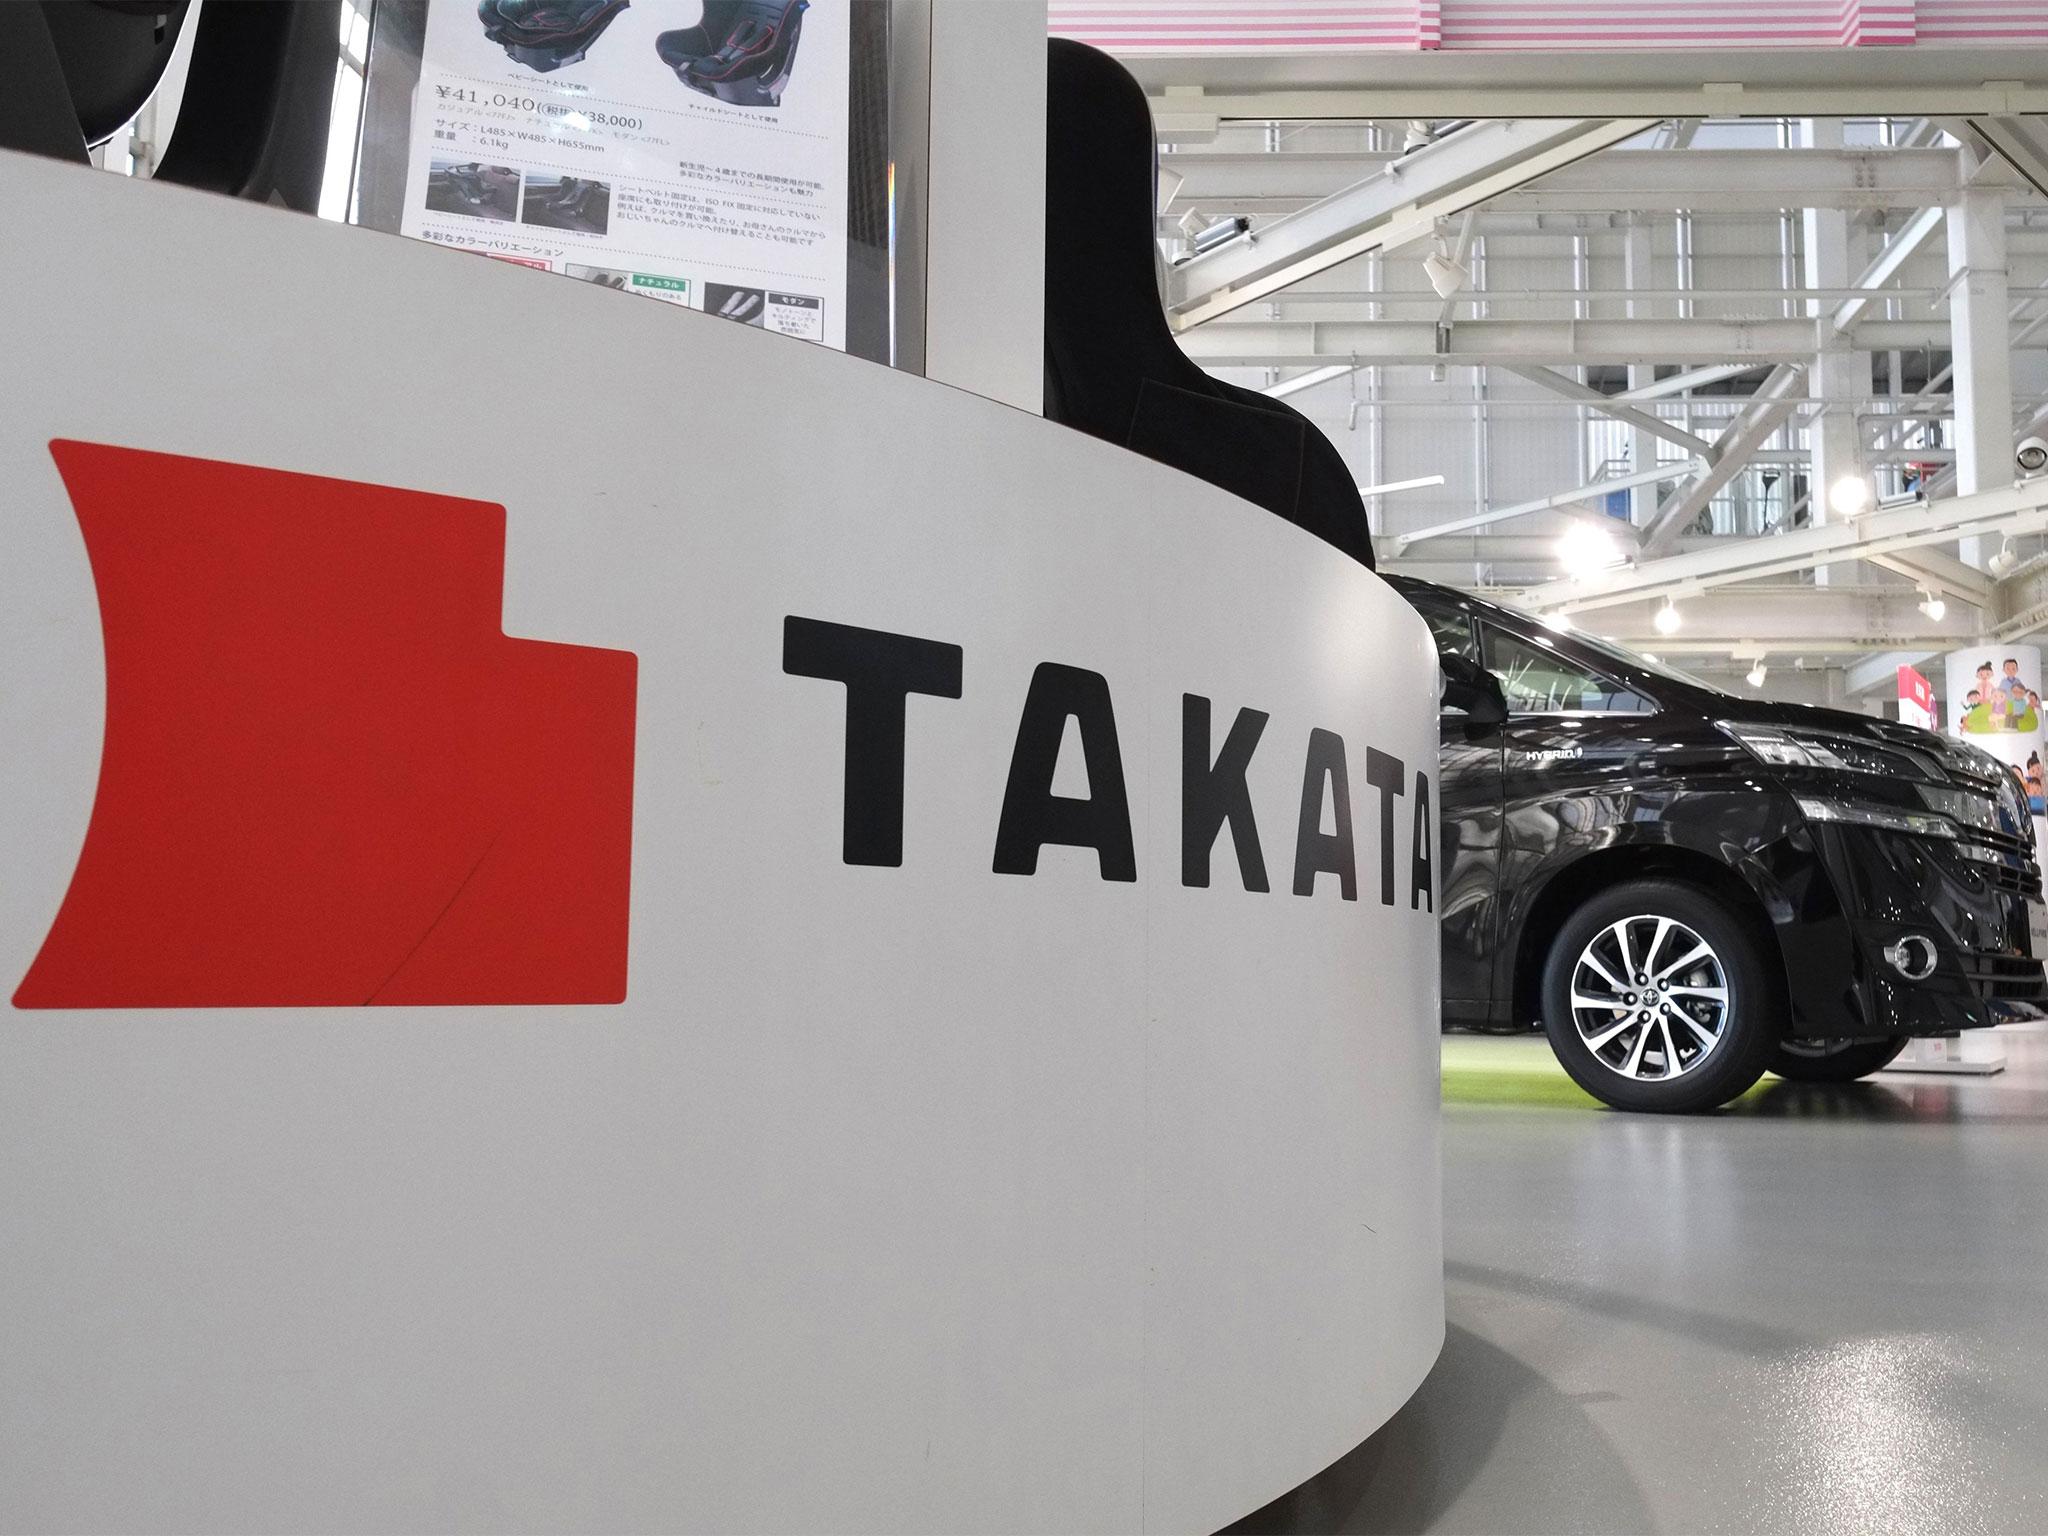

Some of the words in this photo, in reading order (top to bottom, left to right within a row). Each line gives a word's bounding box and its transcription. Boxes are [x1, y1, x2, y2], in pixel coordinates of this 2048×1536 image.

[421, 229, 564, 257] 多彩なカラーバリエーション
[782, 614, 1433, 914] TAKATA
